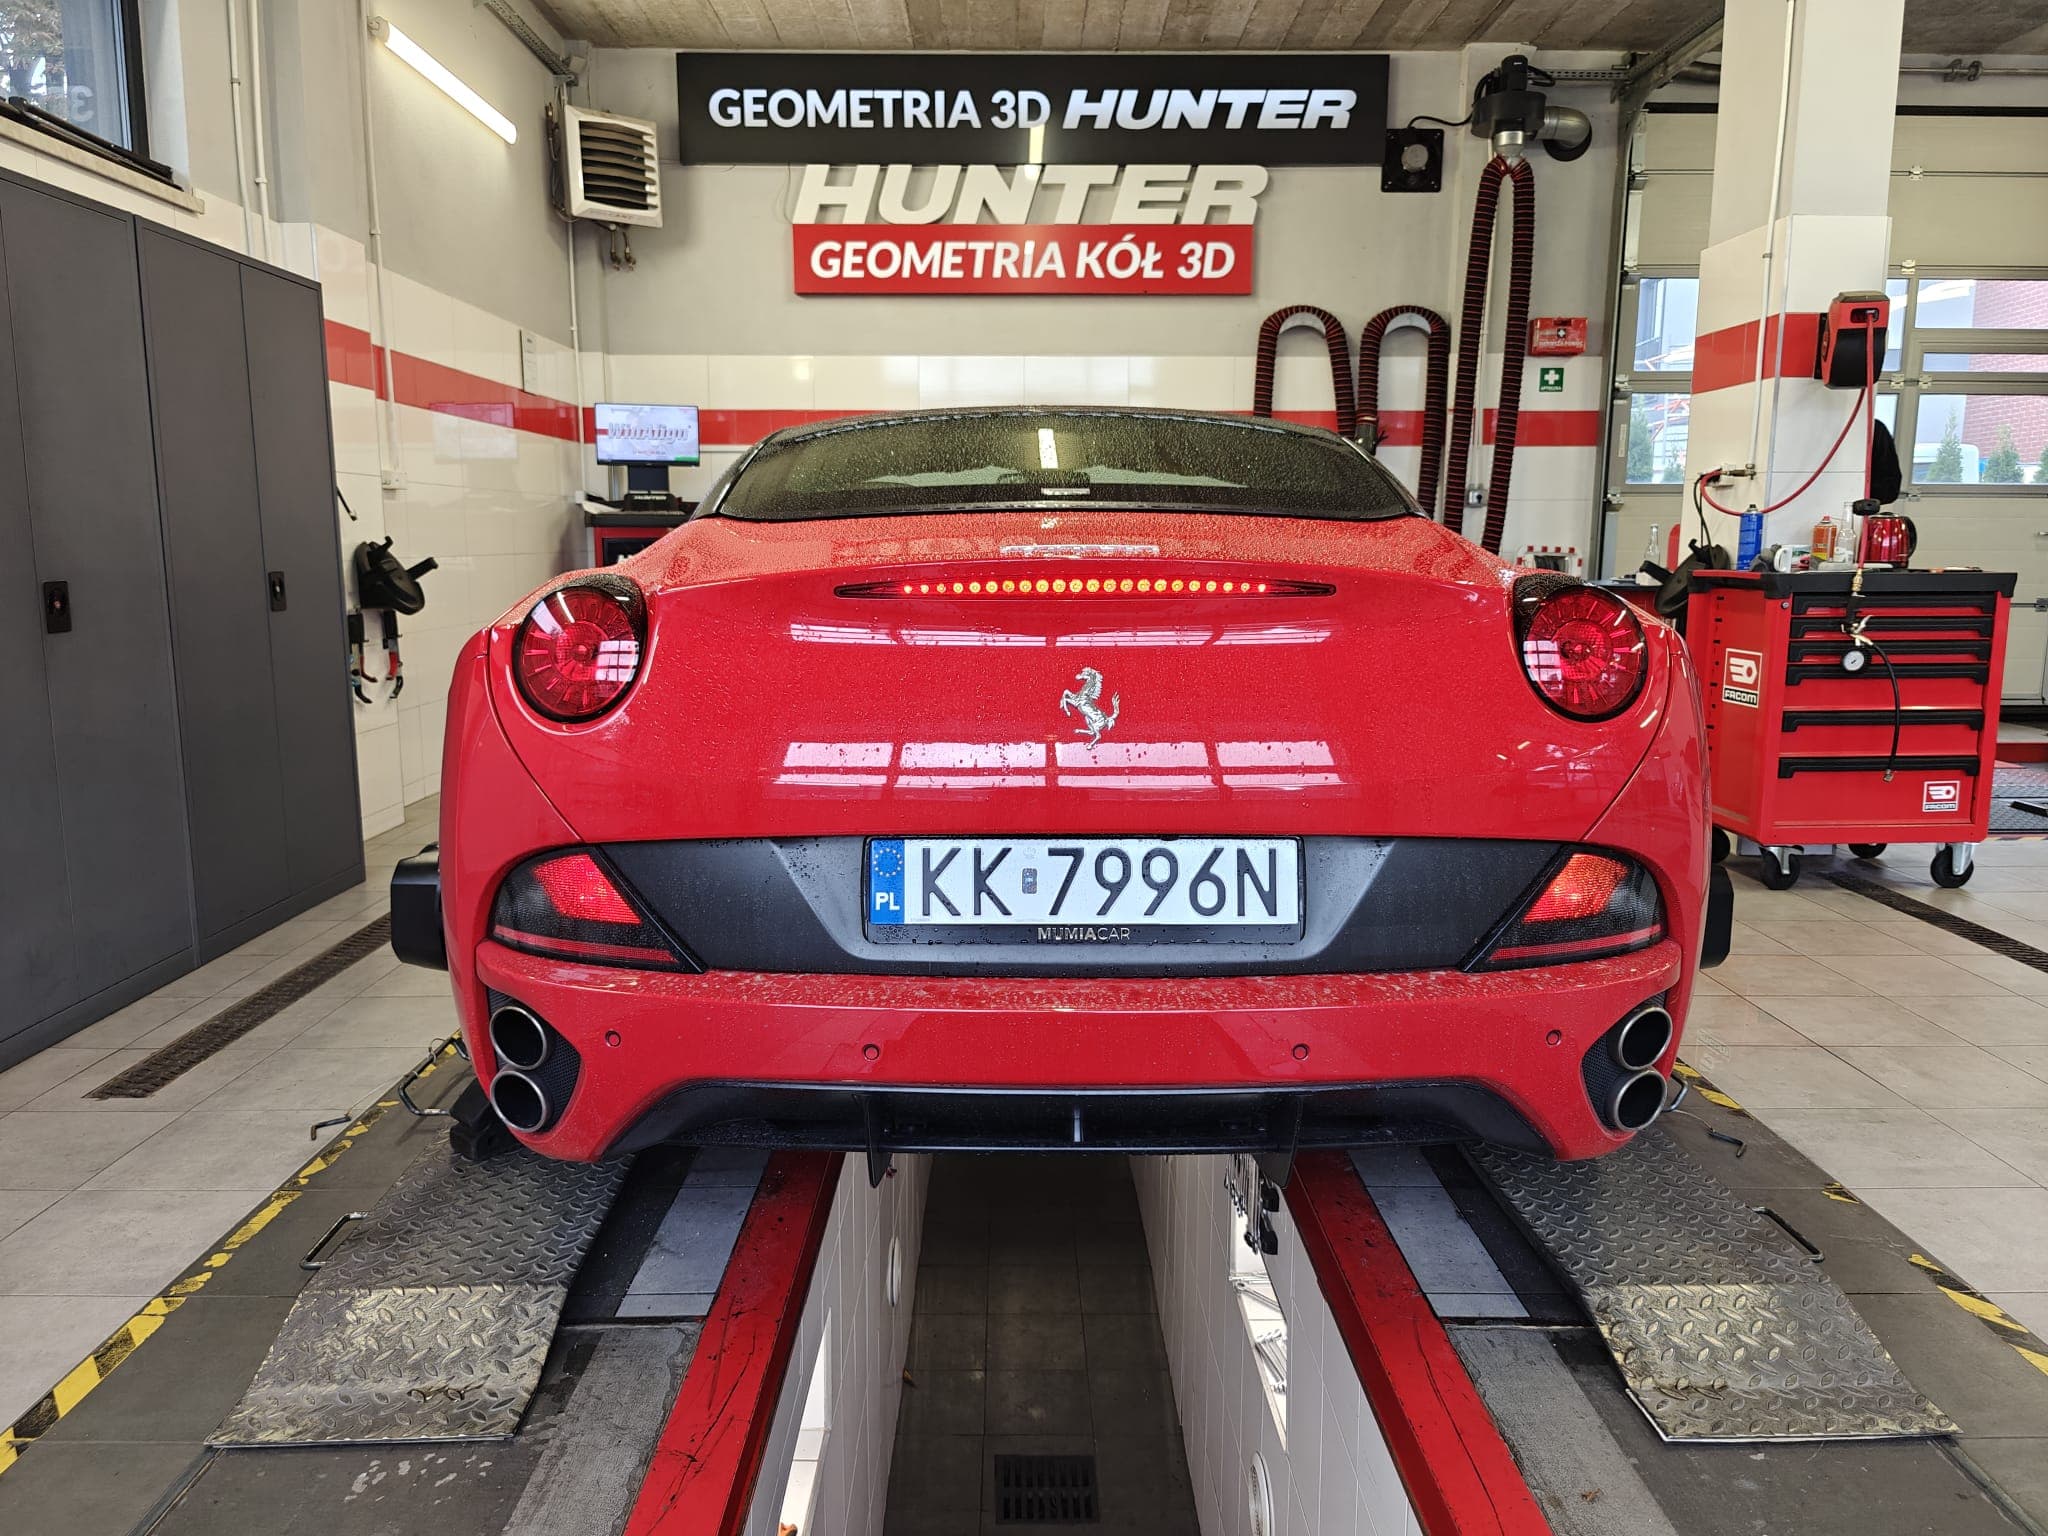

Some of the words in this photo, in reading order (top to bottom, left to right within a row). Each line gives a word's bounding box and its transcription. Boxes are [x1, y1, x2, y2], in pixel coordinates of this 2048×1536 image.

[709, 88, 981, 129] GEOMETRIA
[991, 90, 1051, 127] 3D
[1062, 89, 1357, 130] HUNTER
[792, 164, 1268, 225] HUNTER
[811, 240, 1066, 279] GEOMETRIA
[1075, 234, 1164, 279] KÓŁ
[1178, 241, 1235, 279] 3D
[1724, 690, 1757, 704] FACOM
[875, 892, 900, 911] PL
[922, 847, 1012, 916] KK
[1048, 847, 1277, 916] 7996N
[1037, 927, 1130, 940] MUMIACAR
